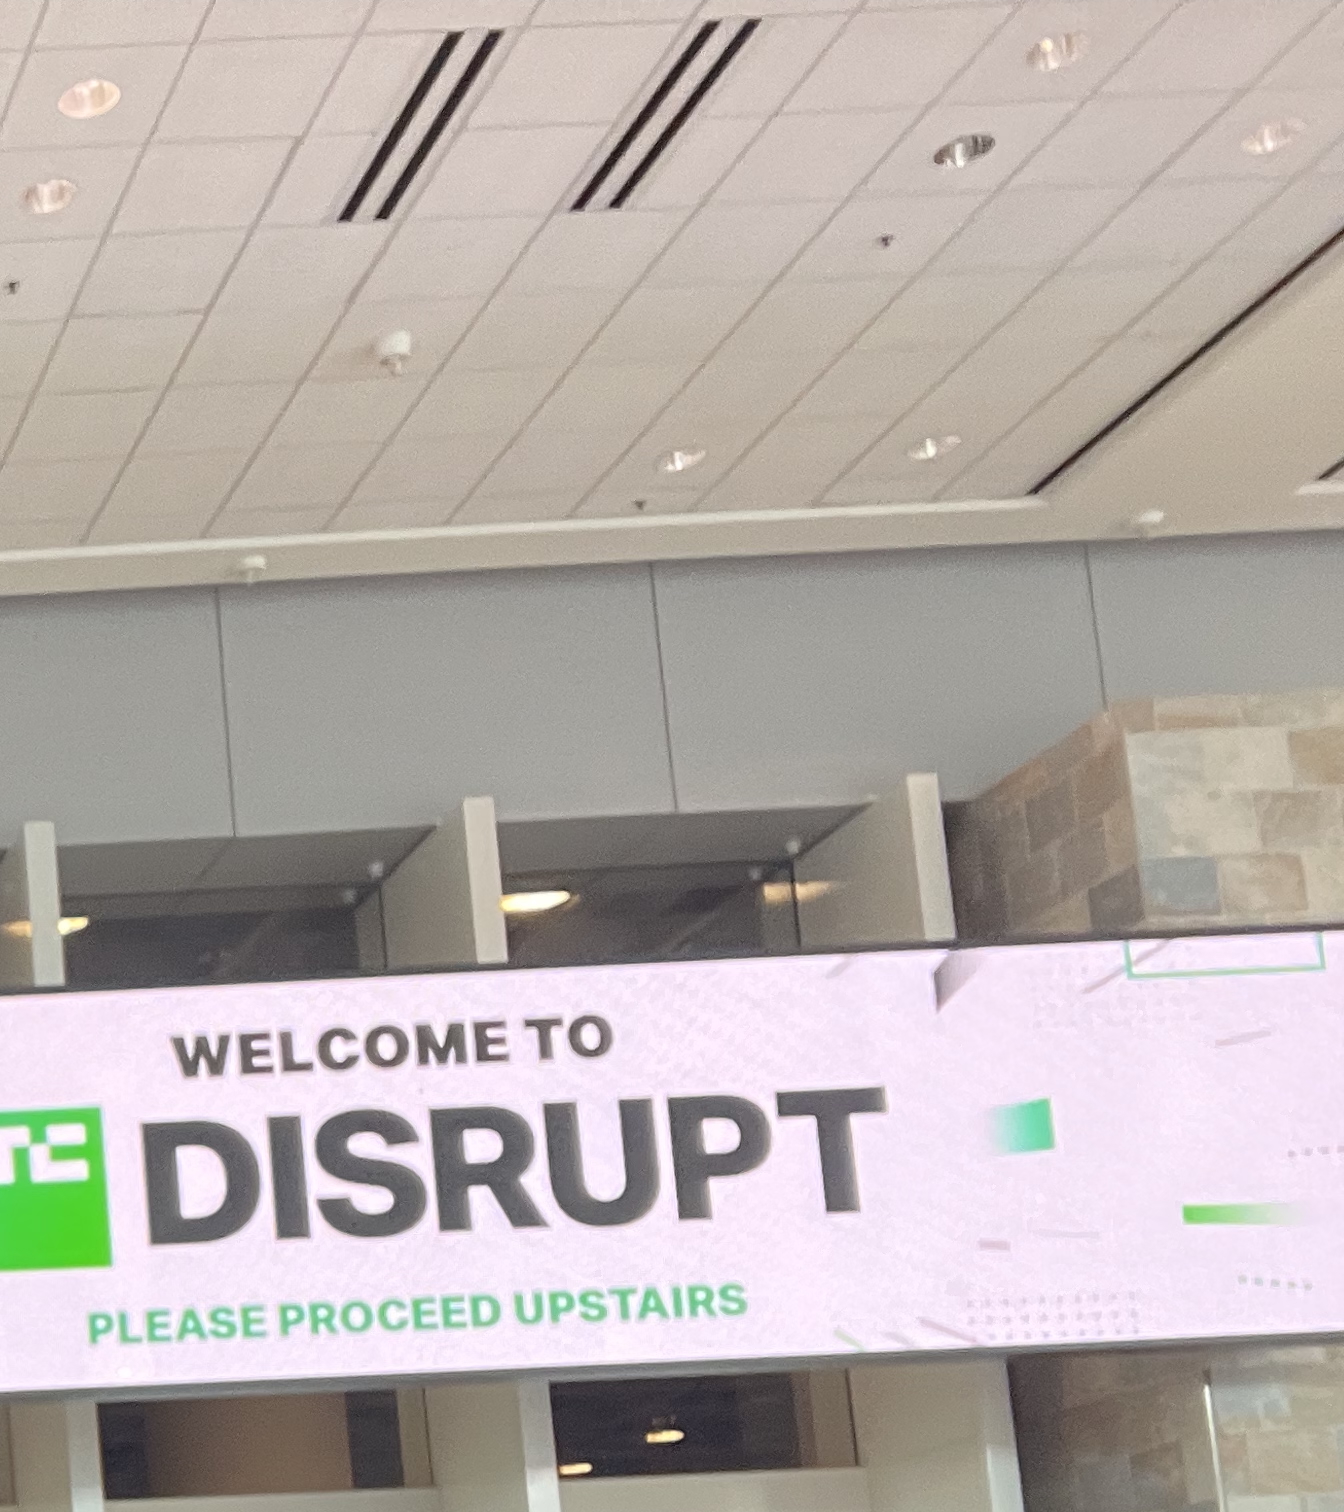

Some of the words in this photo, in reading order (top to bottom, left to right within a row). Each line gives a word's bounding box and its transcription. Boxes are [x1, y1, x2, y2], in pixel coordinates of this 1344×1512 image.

[170, 1019, 510, 1078] WELCOME
[523, 1014, 614, 1060] TO
[139, 1086, 887, 1246] DISRUPT
[87, 1304, 268, 1345] PLEASE
[279, 1293, 502, 1337] PROCEED
[513, 1283, 748, 1325] UPSTAIRS
